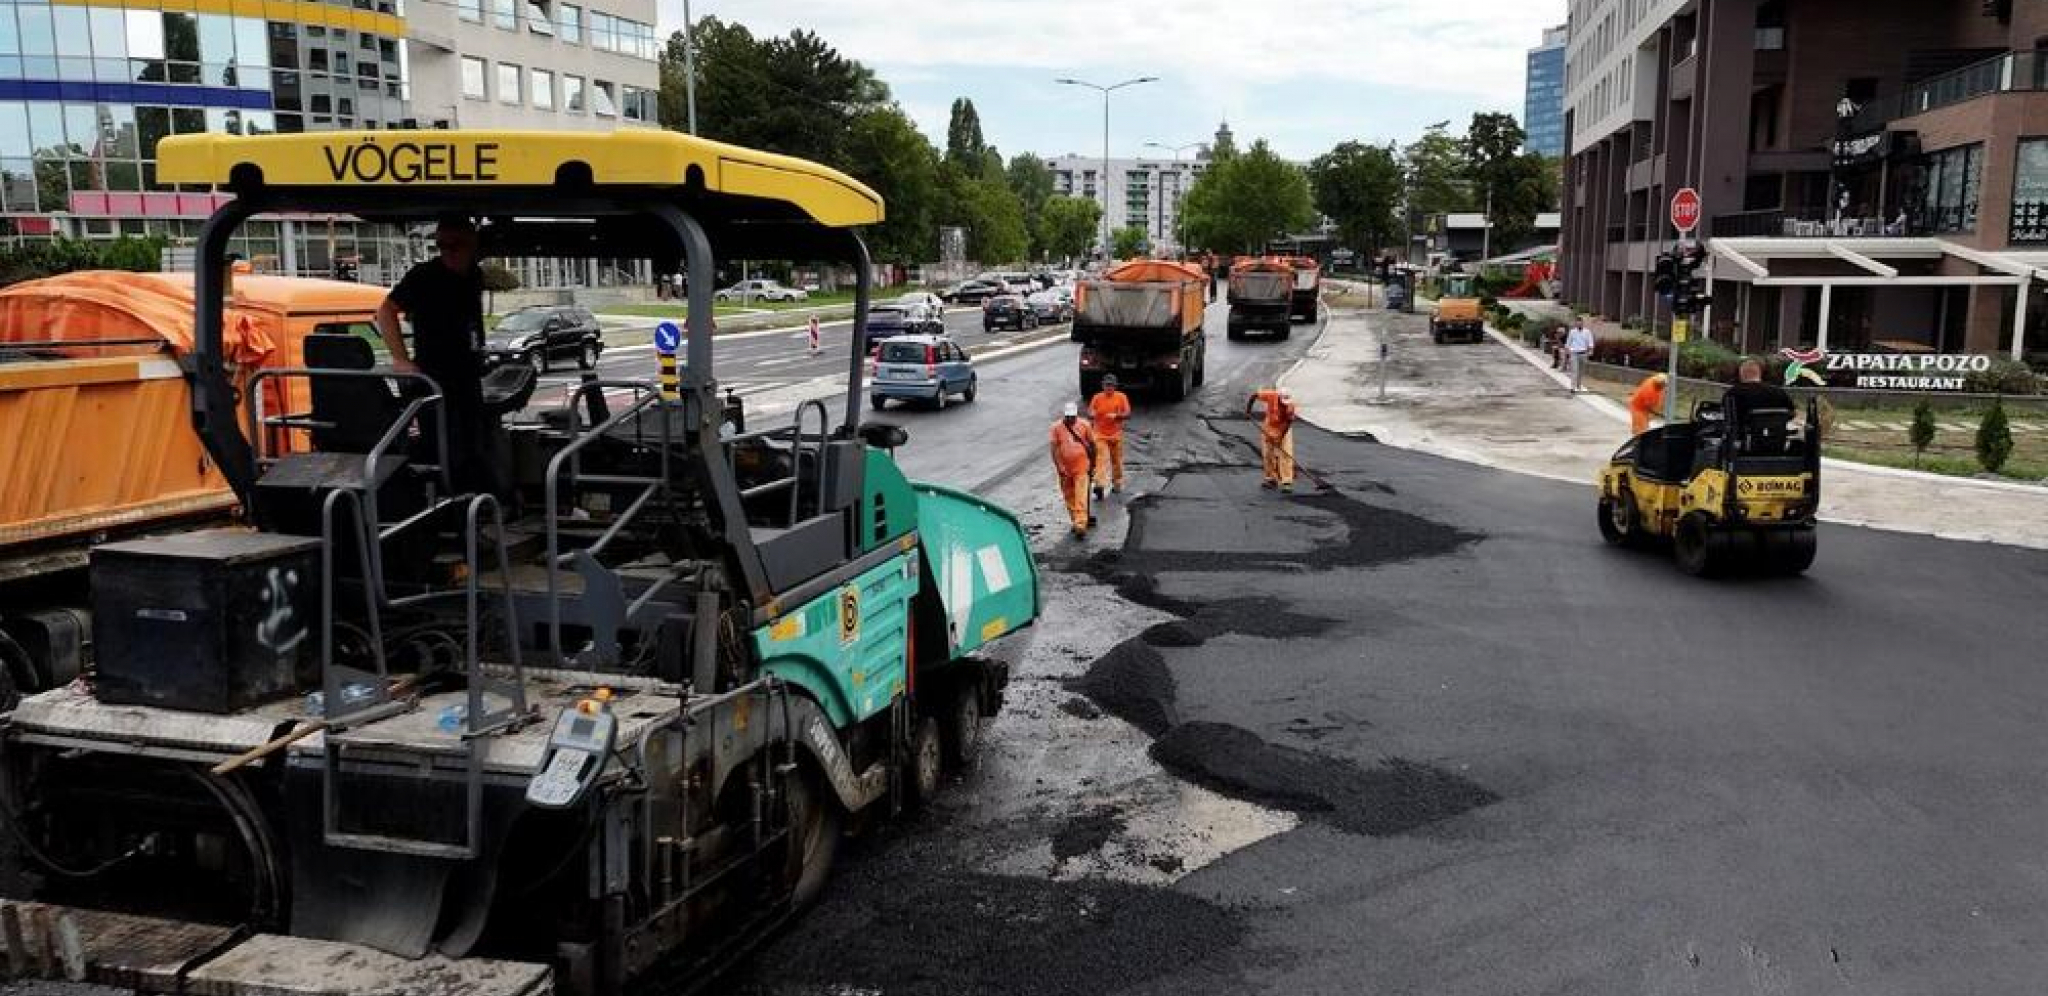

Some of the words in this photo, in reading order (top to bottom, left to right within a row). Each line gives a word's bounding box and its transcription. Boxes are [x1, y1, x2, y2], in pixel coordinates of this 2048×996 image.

[323, 136, 499, 182] VÖGELE
[1674, 203, 1697, 217] STOP
[1826, 353, 1912, 370] ZAPATA
[1920, 354, 1990, 371] POZO
[1857, 376, 1966, 389] RESTAURANT
[1756, 481, 1801, 491] BOMAG
